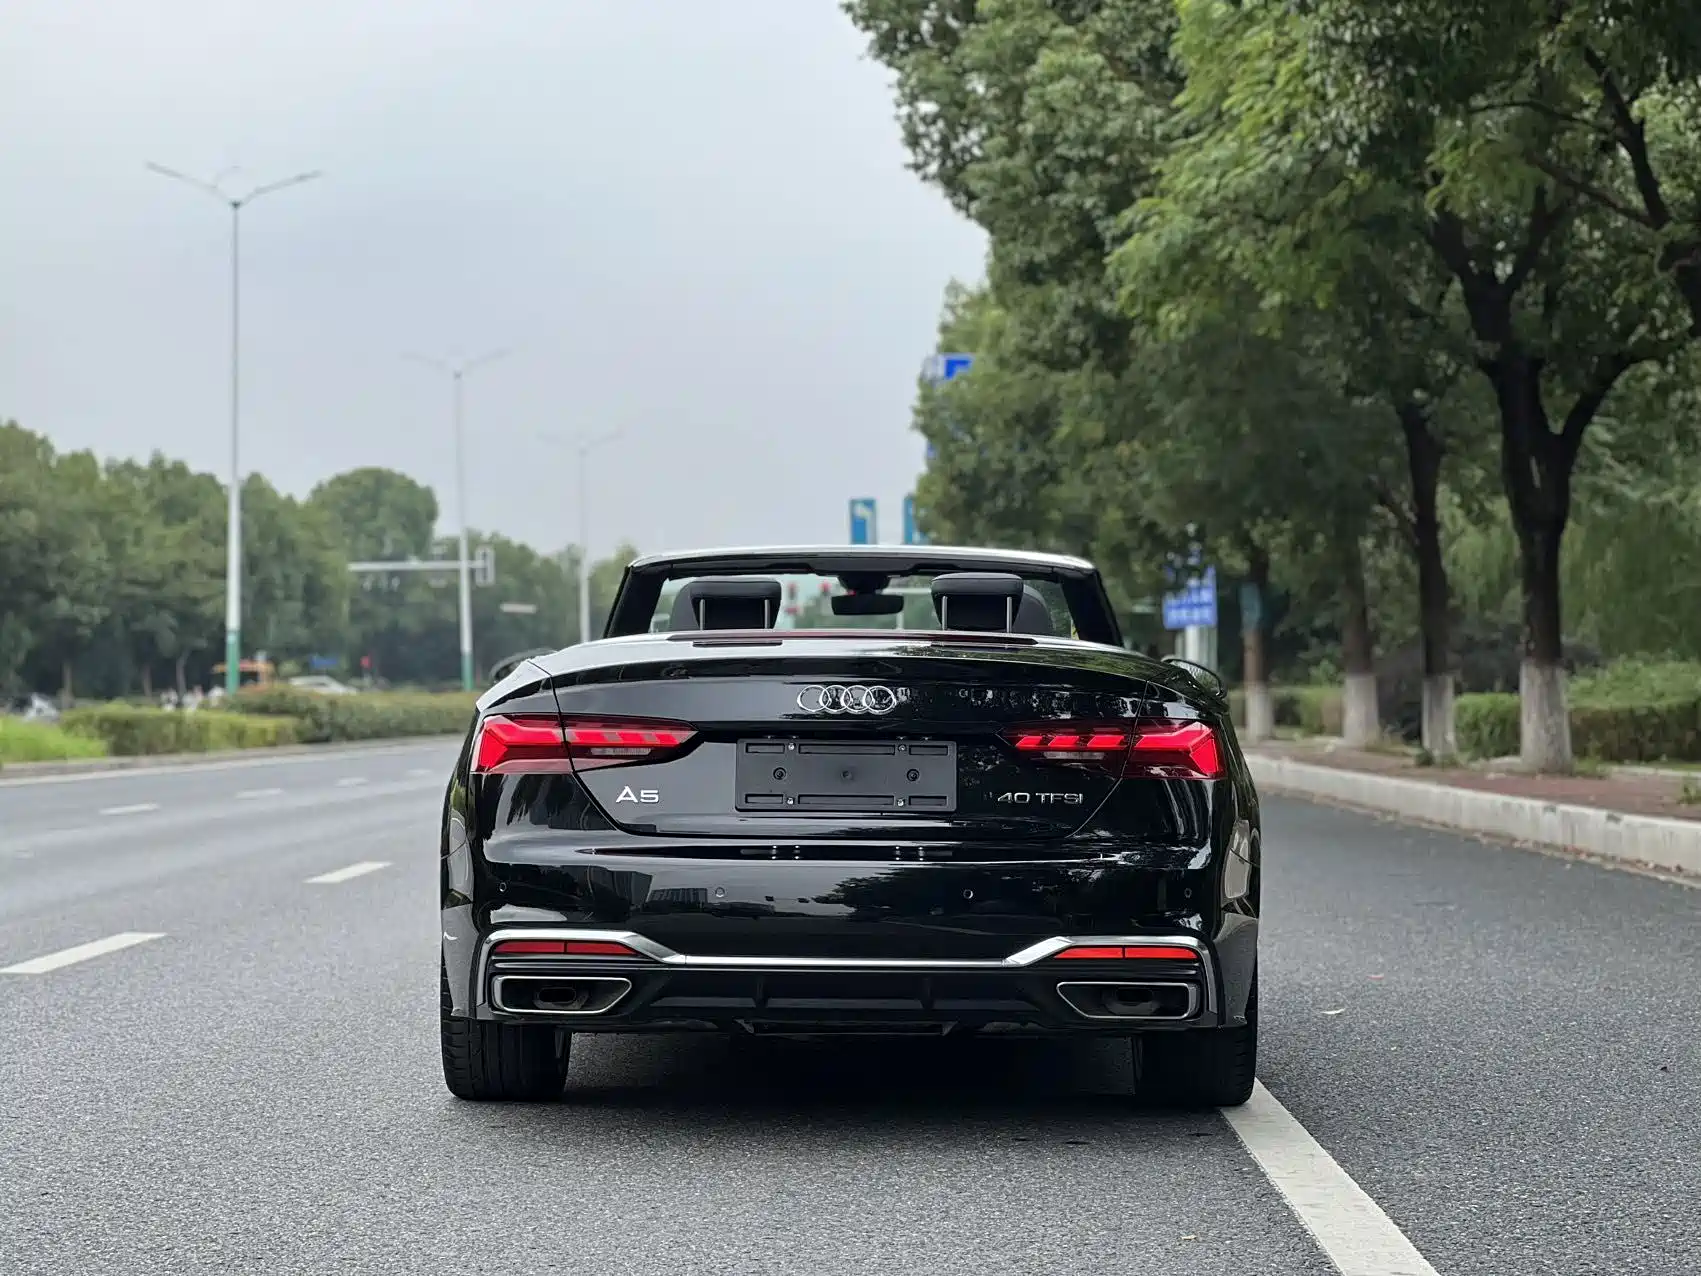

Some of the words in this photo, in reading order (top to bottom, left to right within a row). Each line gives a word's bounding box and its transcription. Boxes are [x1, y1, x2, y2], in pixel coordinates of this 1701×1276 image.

[615, 785, 659, 803] A5
[997, 792, 1030, 804] 40
[1035, 792, 1084, 805] TFSI
